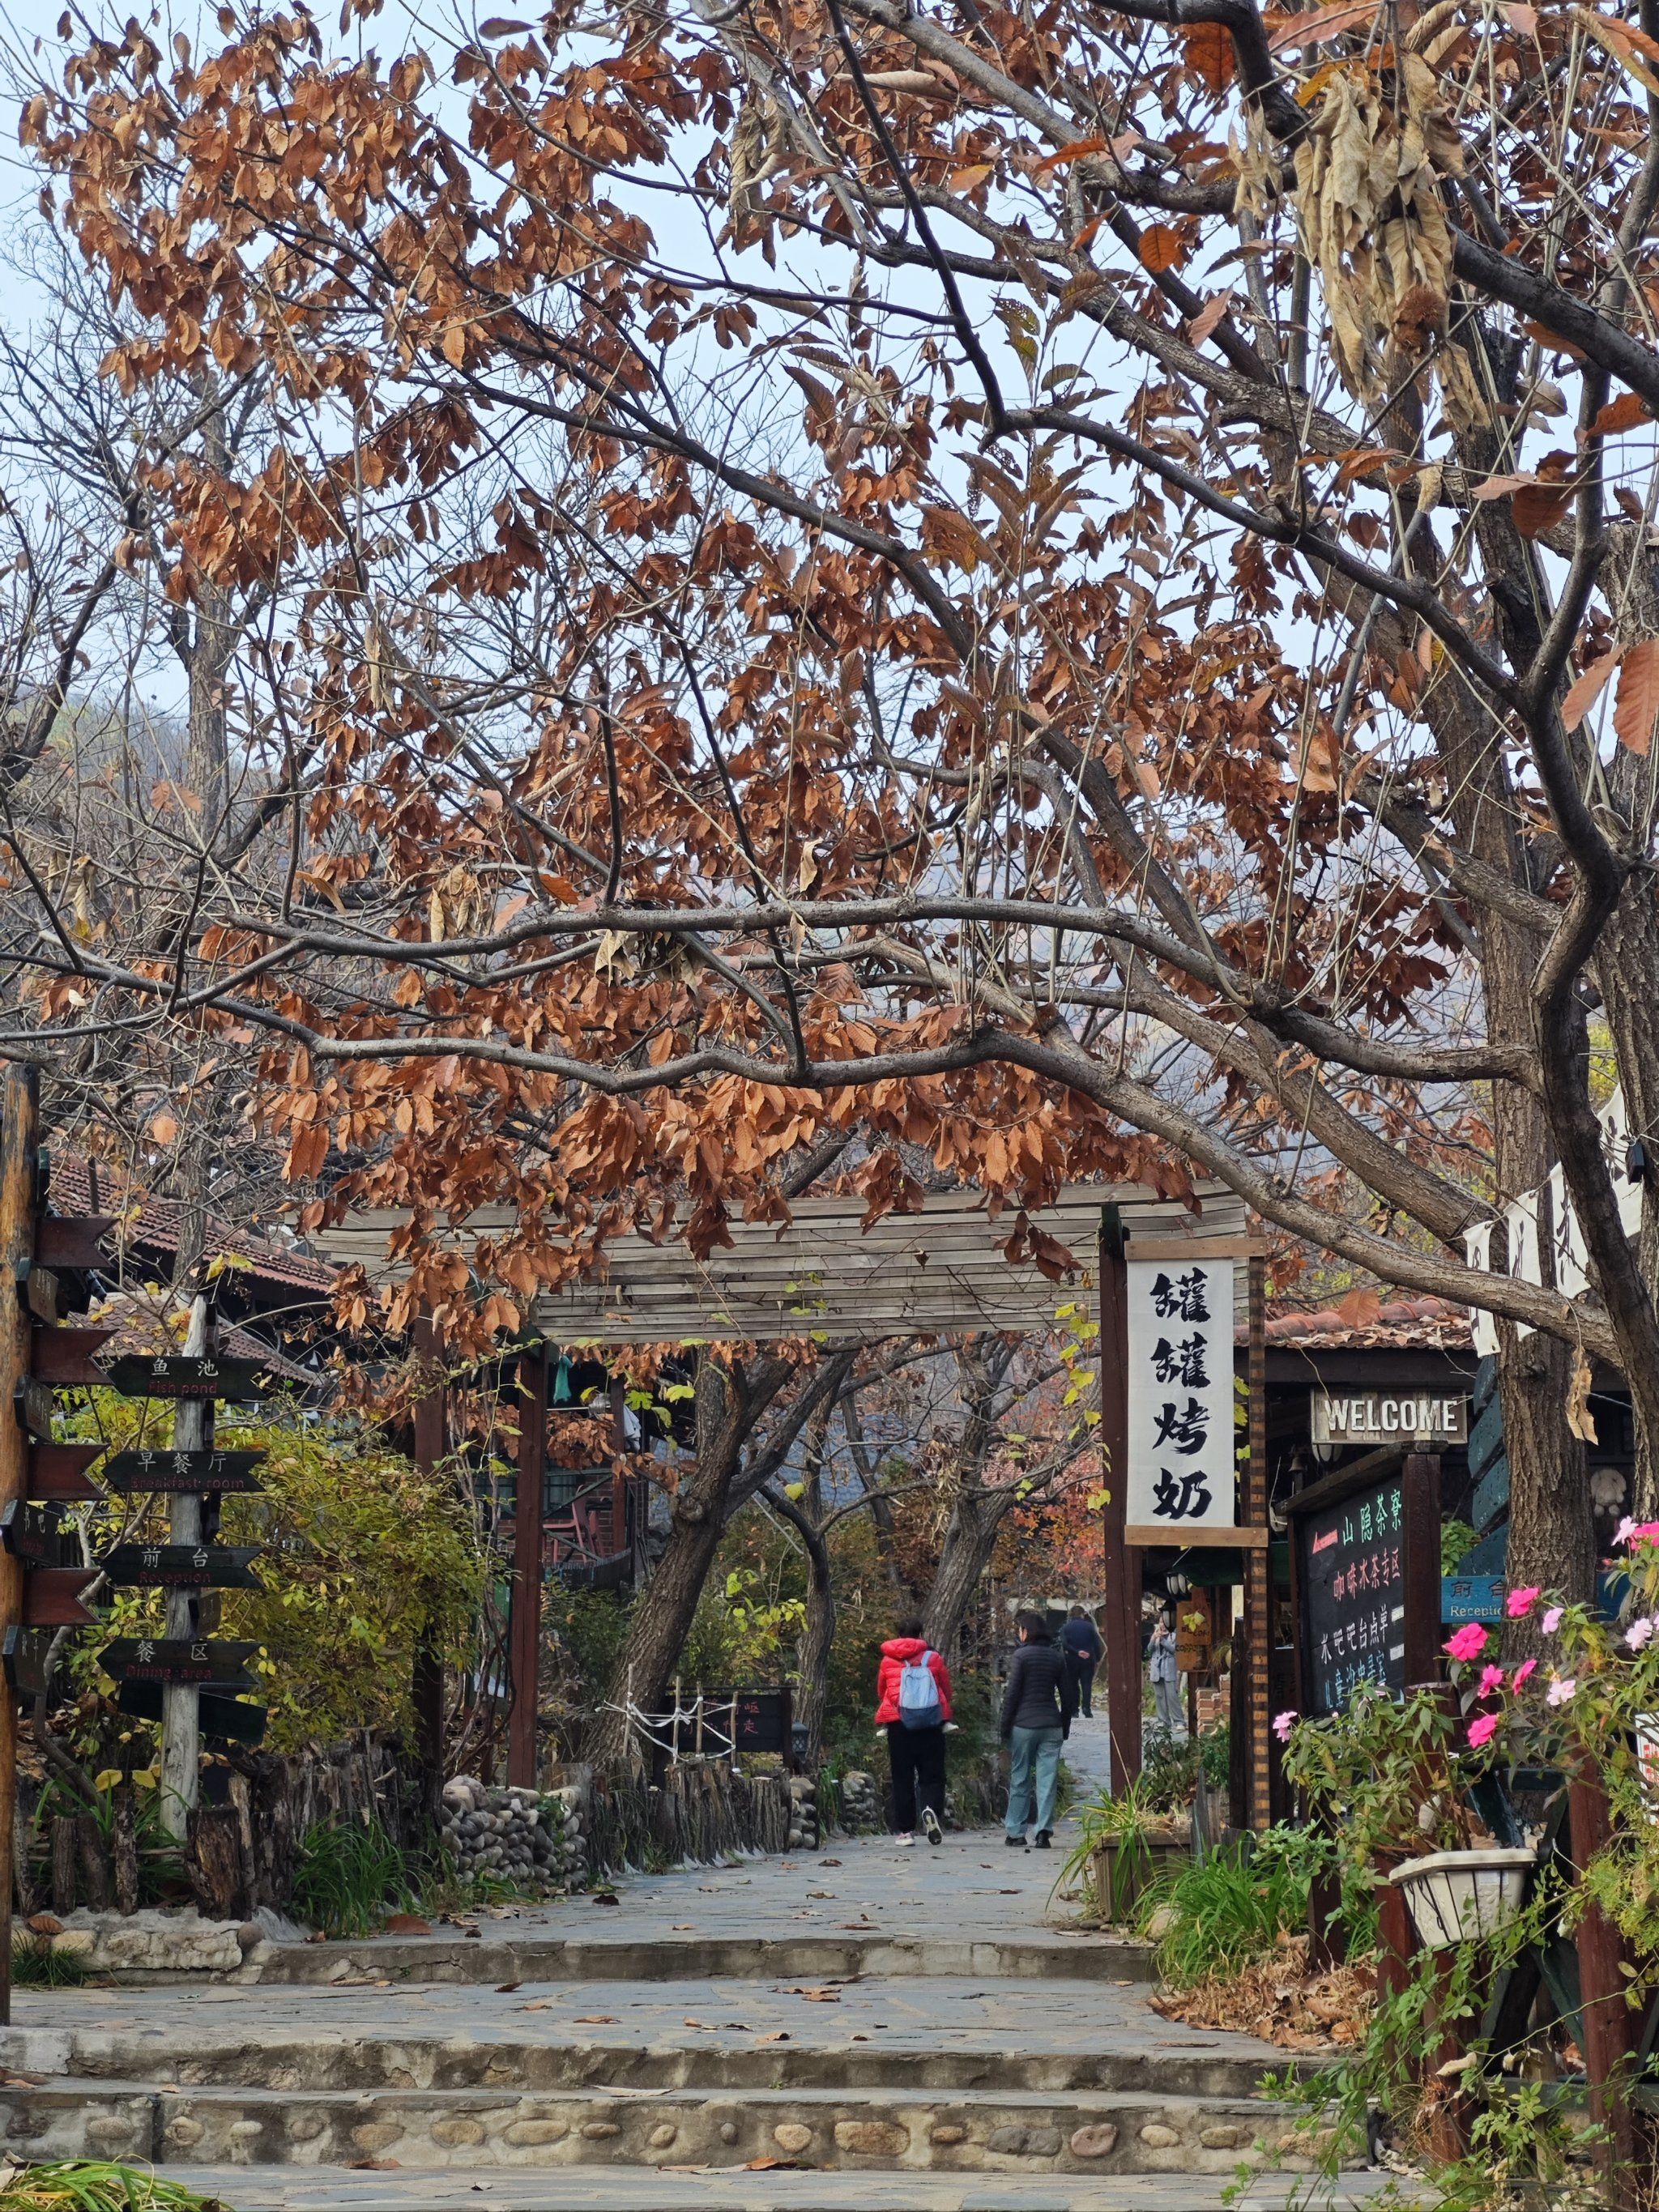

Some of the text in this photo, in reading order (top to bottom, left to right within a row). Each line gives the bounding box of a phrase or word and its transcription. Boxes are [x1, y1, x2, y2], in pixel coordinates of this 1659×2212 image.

[151, 1357, 219, 1377] 鱼池
[148, 1380, 218, 1396] Fish pond
[1149, 1268, 1213, 1519] 罐罐烤奶
[1324, 1399, 1458, 1431] WELCOME
[137, 1451, 227, 1474] 早餐厅
[130, 1476, 244, 1489] Breakfast room
[1342, 1489, 1402, 1546] 山隐茶寮
[141, 1546, 208, 1568] 前台
[138, 1571, 211, 1585] Reception
[1450, 1605, 1502, 1617] Recepti
[134, 1640, 208, 1663] 餐区
[126, 1664, 213, 1681] Dining area
